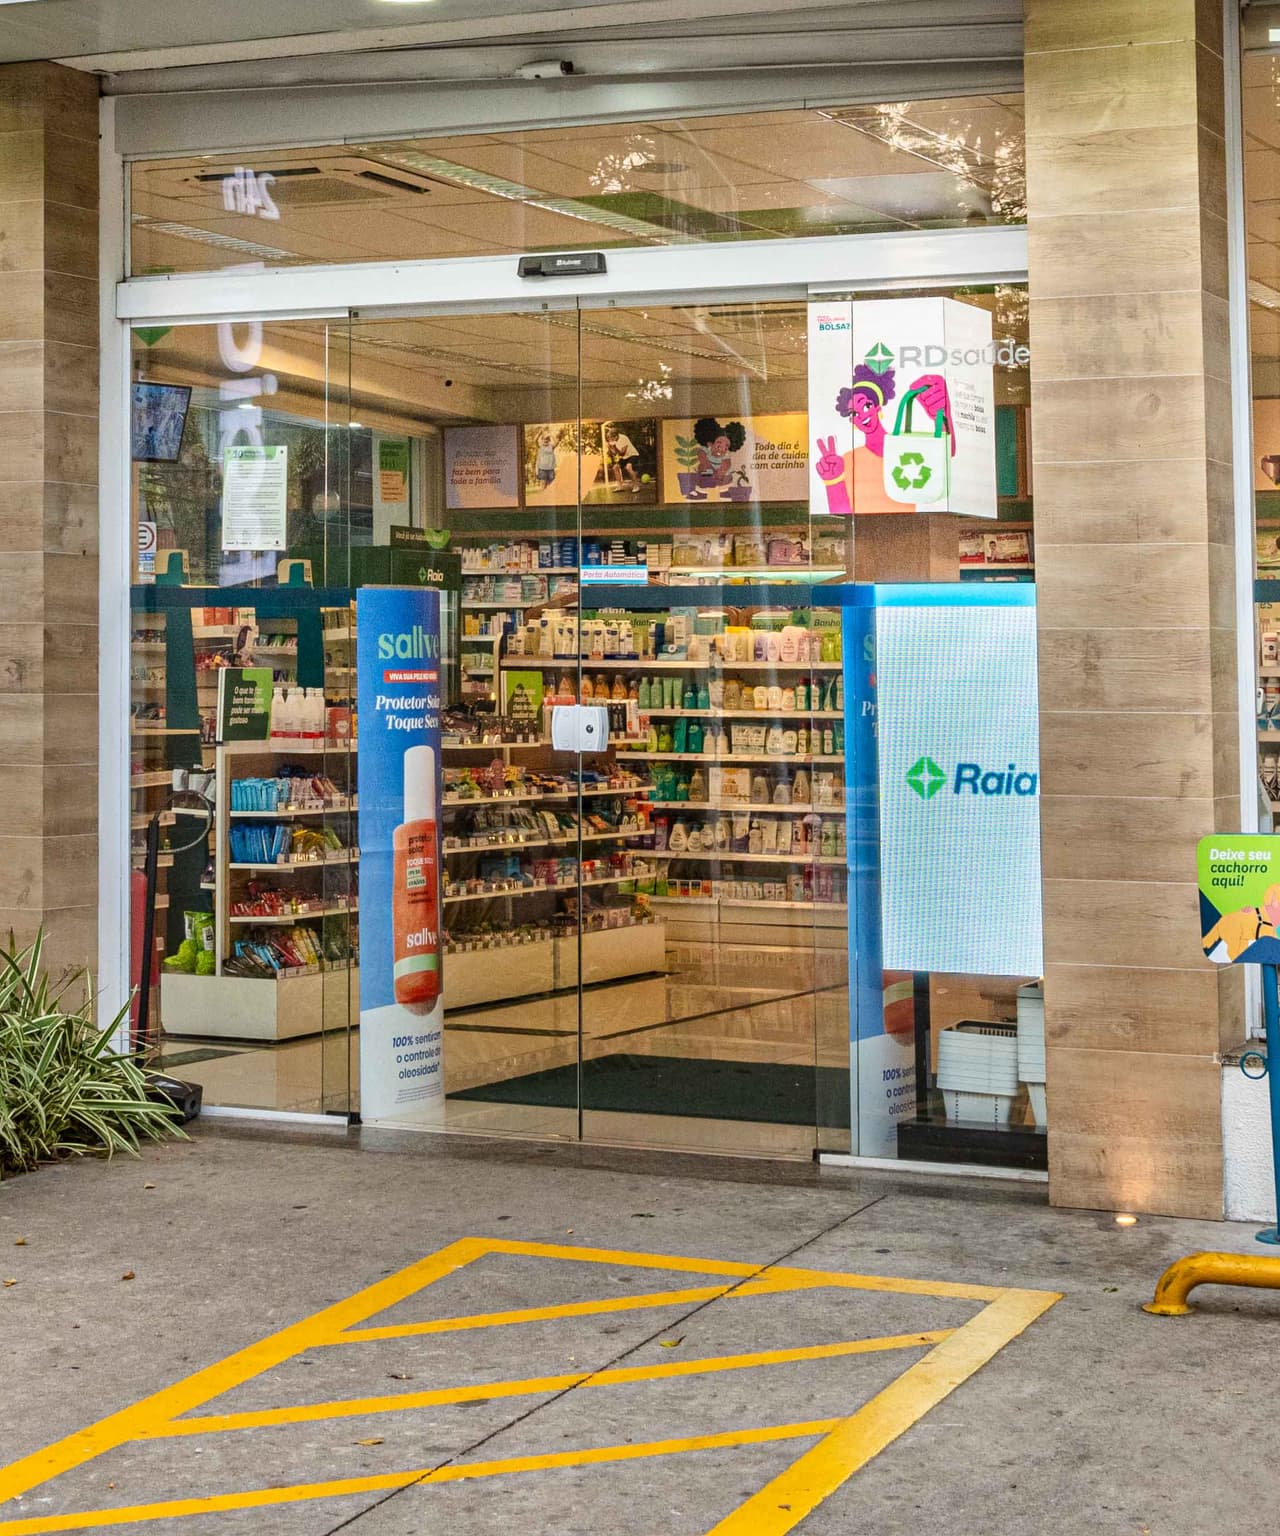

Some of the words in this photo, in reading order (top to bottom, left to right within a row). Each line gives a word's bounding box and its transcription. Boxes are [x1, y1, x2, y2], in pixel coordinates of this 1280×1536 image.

[755, 442, 775, 451] Todo
[777, 441, 791, 450] dia
[794, 440, 799, 449] é
[768, 451, 779, 460] de
[771, 460, 805, 469] carinho
[427, 568, 444, 582] Raia
[378, 625, 439, 660] sallve
[375, 694, 427, 711] Protetor
[385, 714, 424, 733] Toque
[953, 763, 1037, 795] Raia
[1209, 848, 1245, 861] Deixe
[1248, 849, 1272, 861] seu
[1210, 862, 1268, 874] cachorro
[1211, 875, 1245, 889] aqui!
[392, 1035, 414, 1048] 100%
[396, 1055, 402, 1063] o
[404, 1048, 434, 1062] controle
